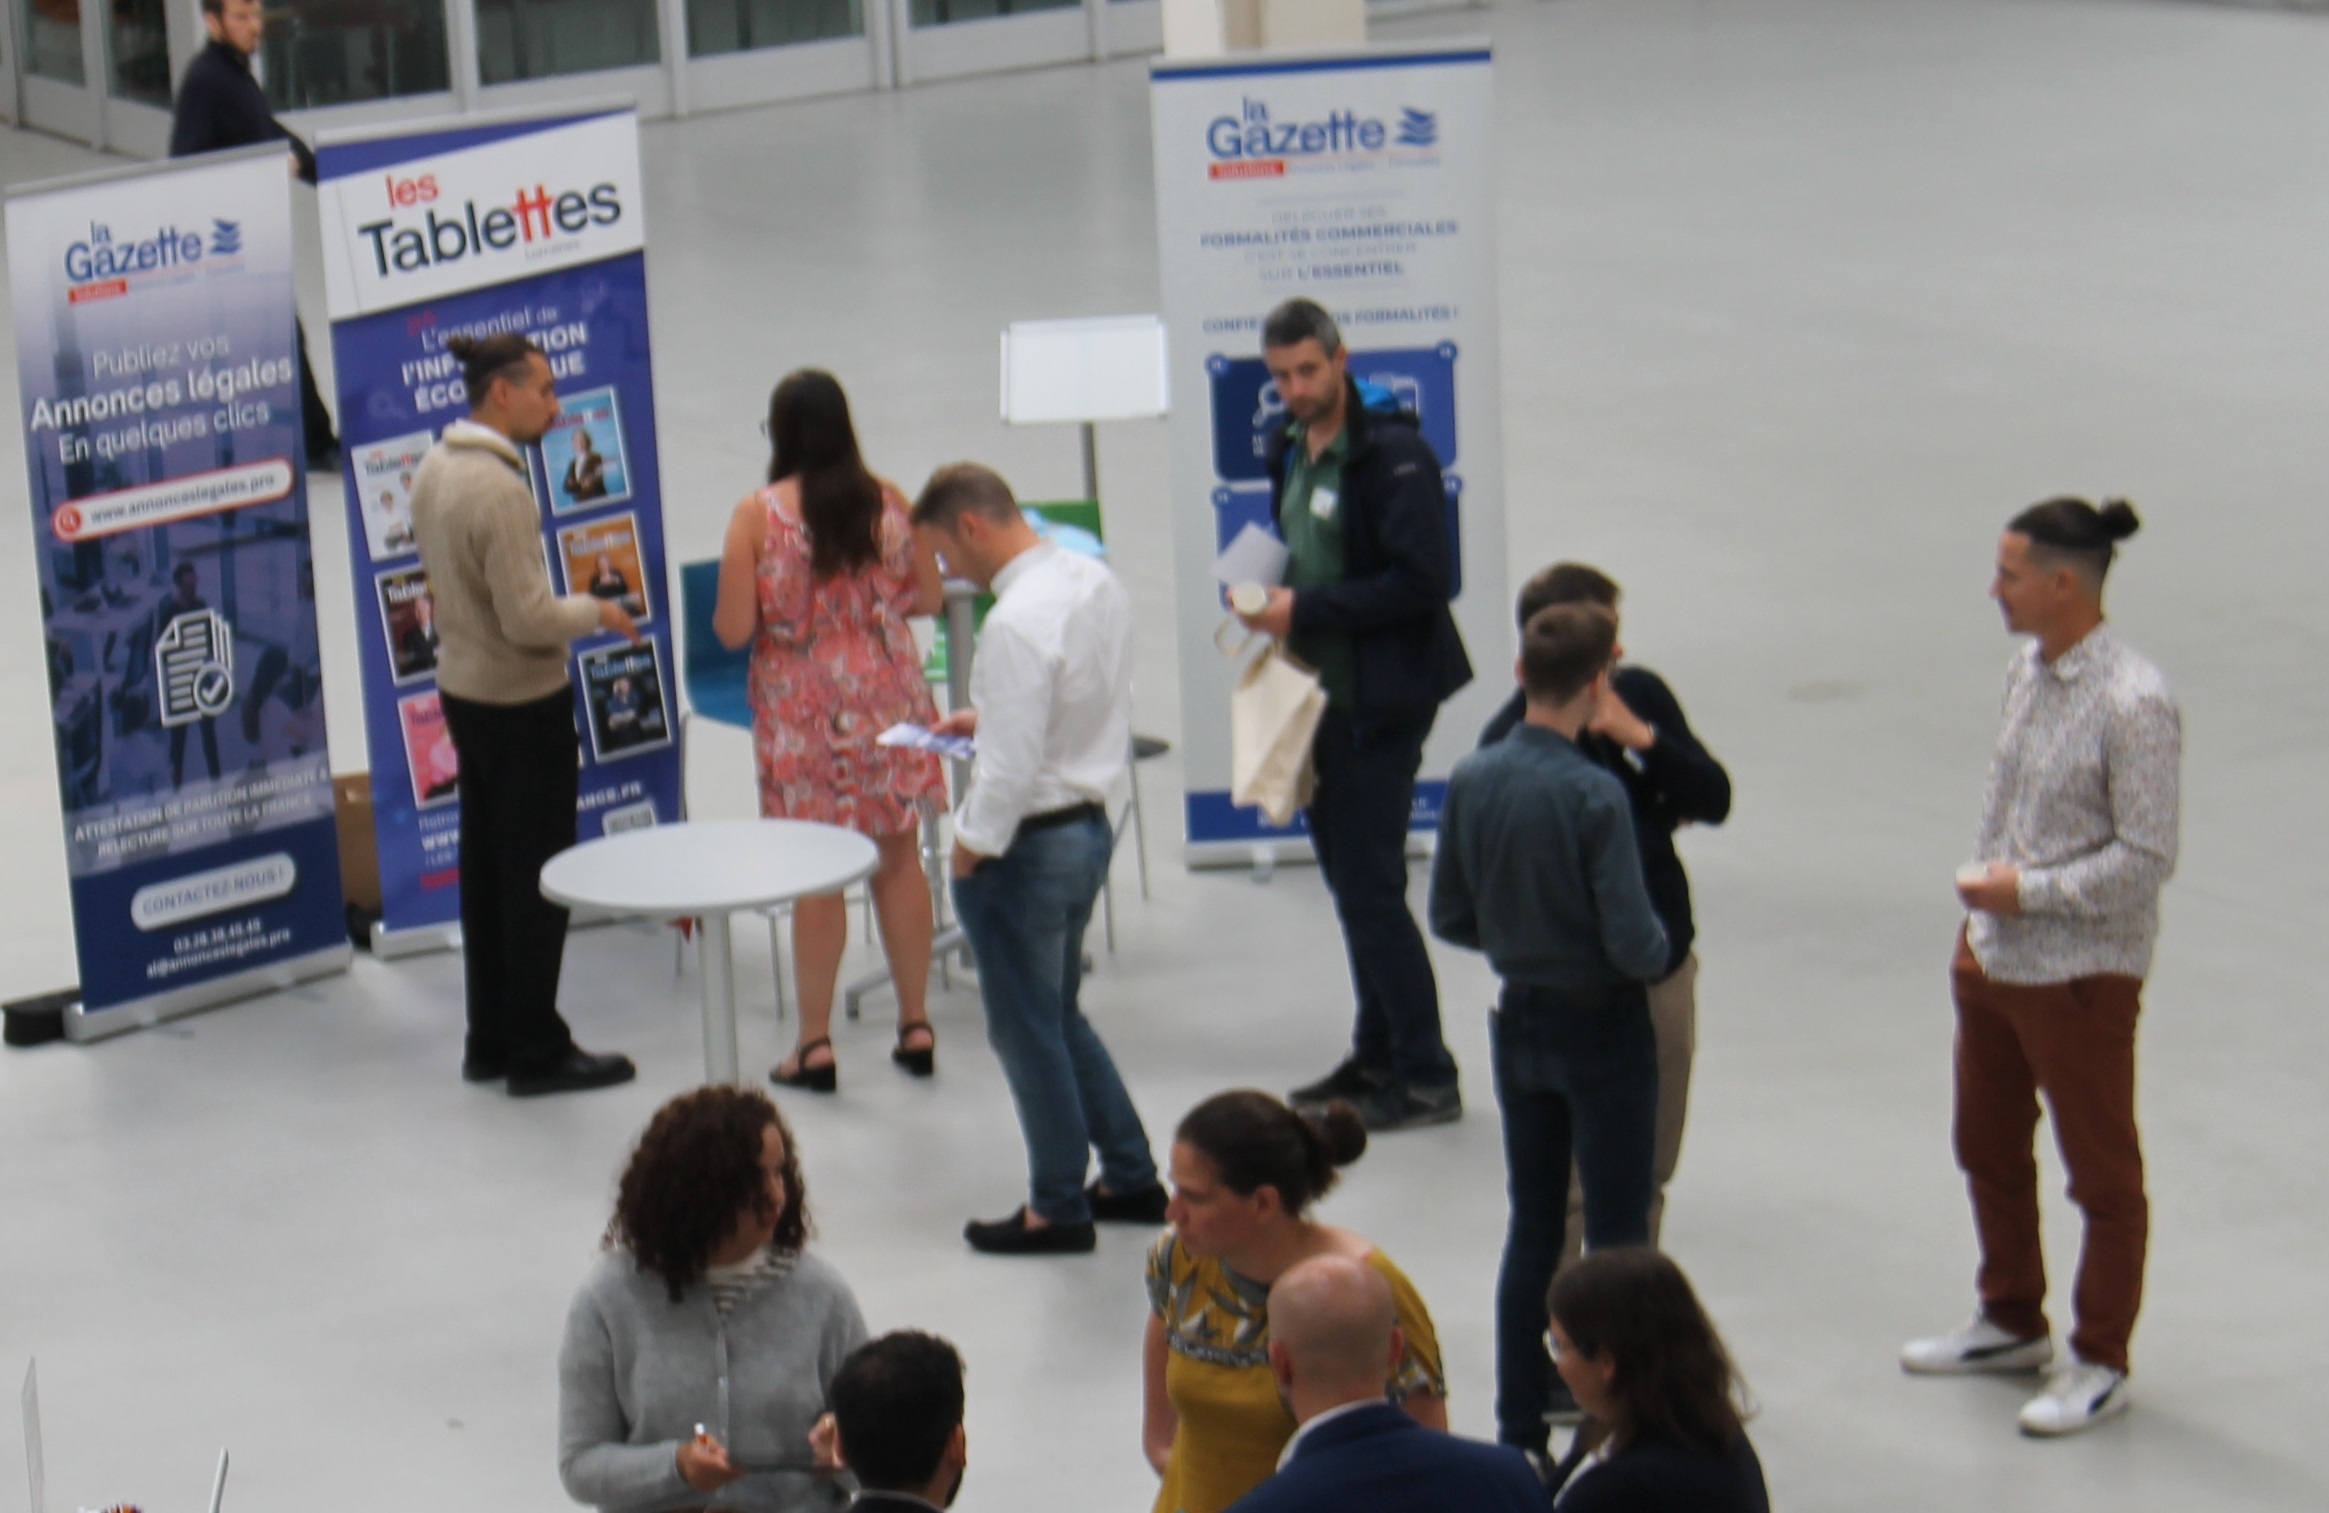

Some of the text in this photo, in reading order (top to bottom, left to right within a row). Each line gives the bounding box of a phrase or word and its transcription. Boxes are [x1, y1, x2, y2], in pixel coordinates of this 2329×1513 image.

[1242, 96, 1268, 121] la
[1206, 109, 1386, 159] Gazette
[386, 173, 440, 209] les
[90, 220, 113, 245] la
[357, 183, 622, 278] Tablettes
[1316, 220, 1458, 243] COMMERCIALES
[65, 226, 202, 282] Gazette
[1203, 316, 1264, 333] CONFIE
[93, 336, 230, 378] Publiez vos
[30, 356, 293, 431] Annonces légales
[58, 401, 271, 465] En quelques clics
